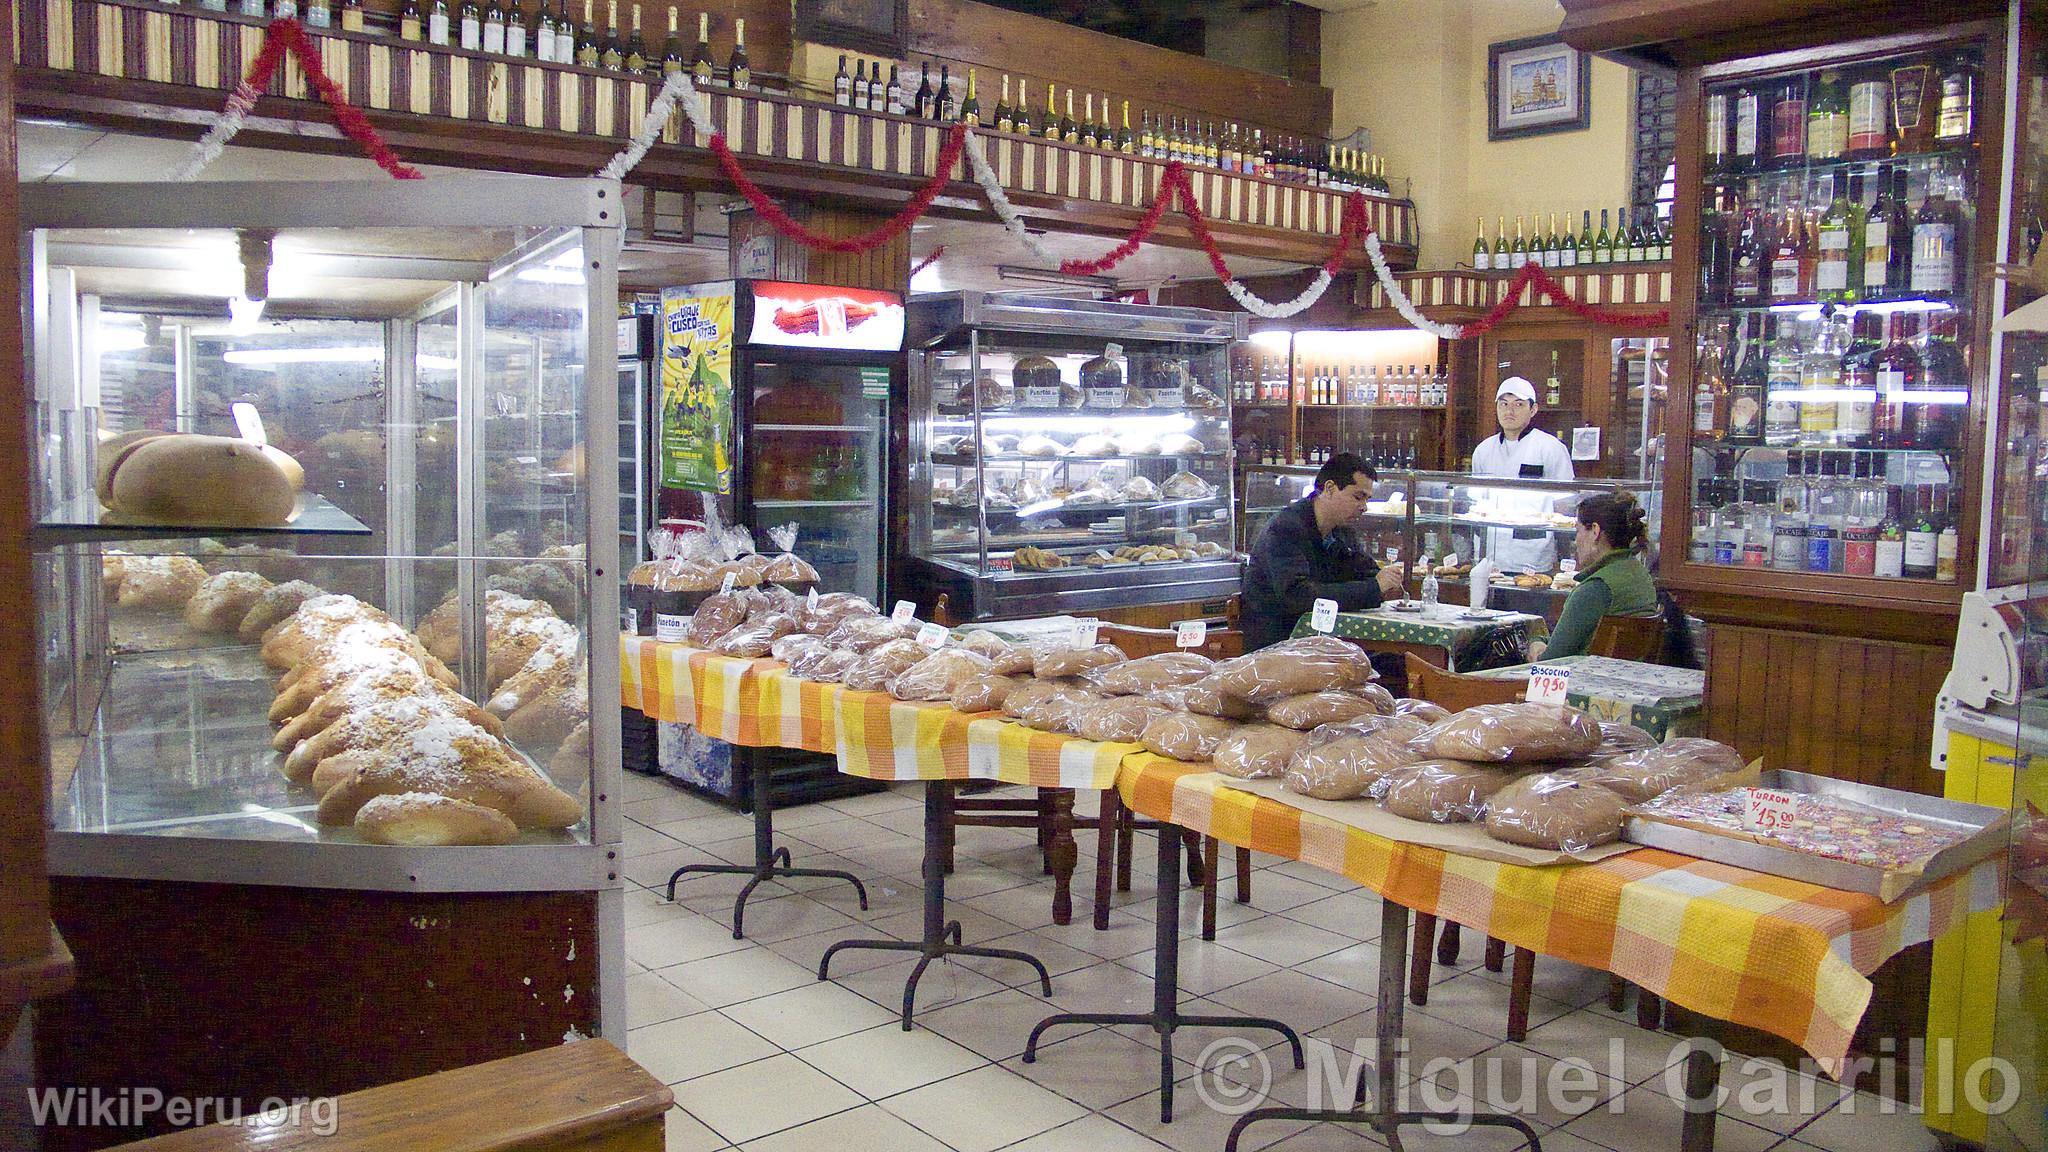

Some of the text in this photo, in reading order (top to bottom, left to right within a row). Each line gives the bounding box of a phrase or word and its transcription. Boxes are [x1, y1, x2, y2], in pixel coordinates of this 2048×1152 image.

[671, 316, 697, 333] CUSCO
[657, 616, 680, 627] Panetón
[1747, 787, 1789, 804] TURRON
